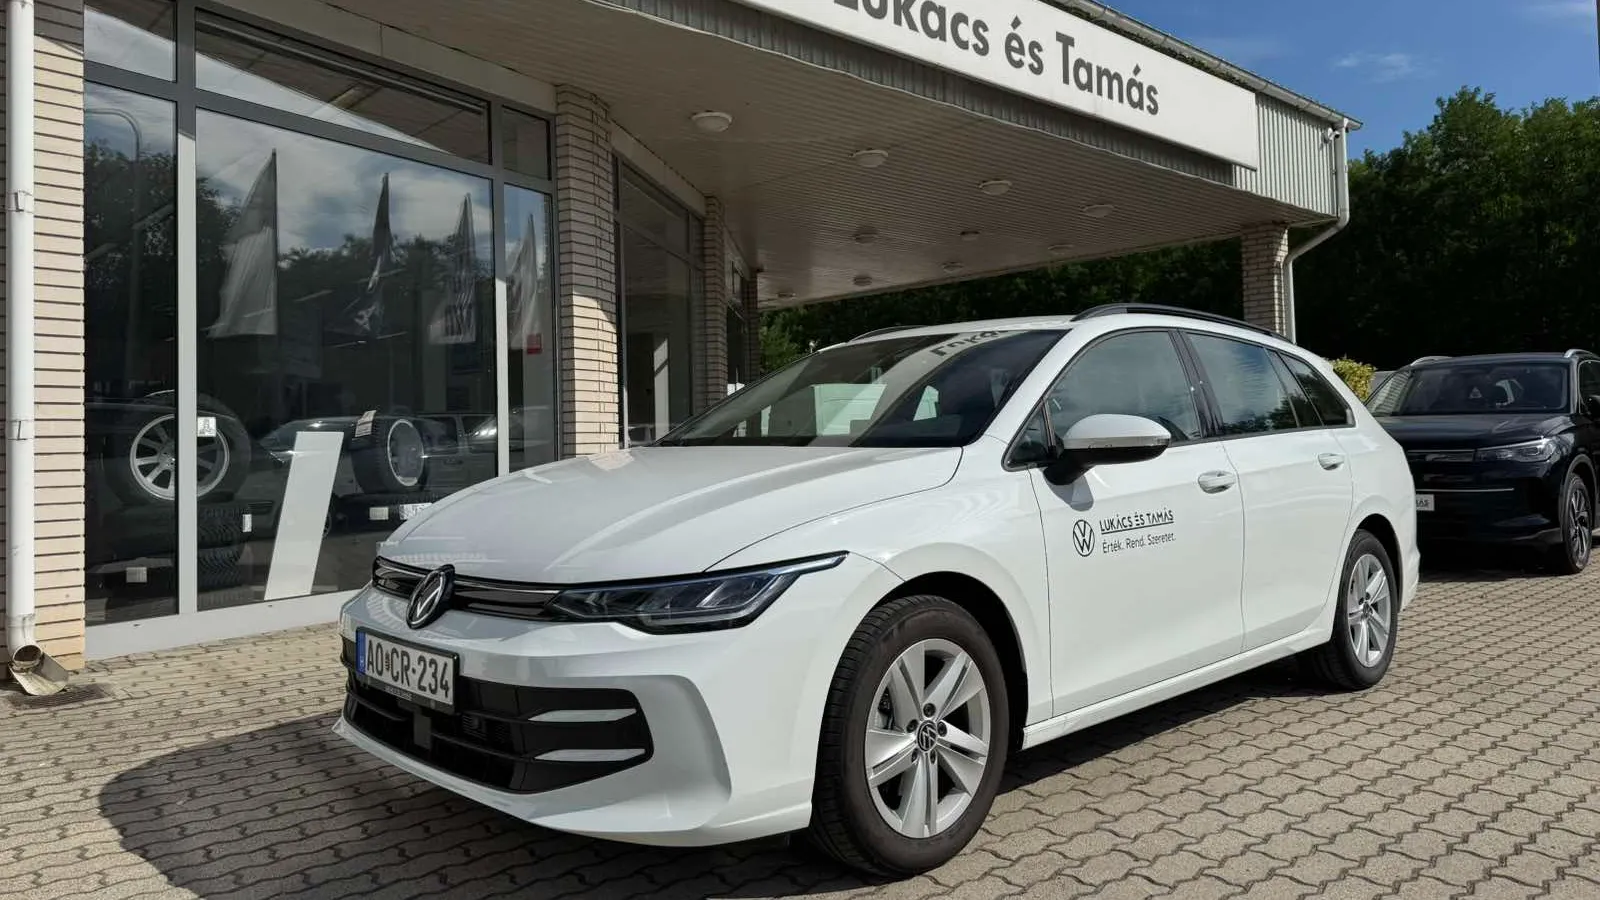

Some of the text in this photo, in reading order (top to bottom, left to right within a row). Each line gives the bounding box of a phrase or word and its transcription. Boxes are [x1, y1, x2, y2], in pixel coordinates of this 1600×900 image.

[1004, 15, 1044, 76] és
[1056, 31, 1159, 116] Tamás
[1099, 507, 1174, 532] LUKÁCS ÉS TAMÁS
